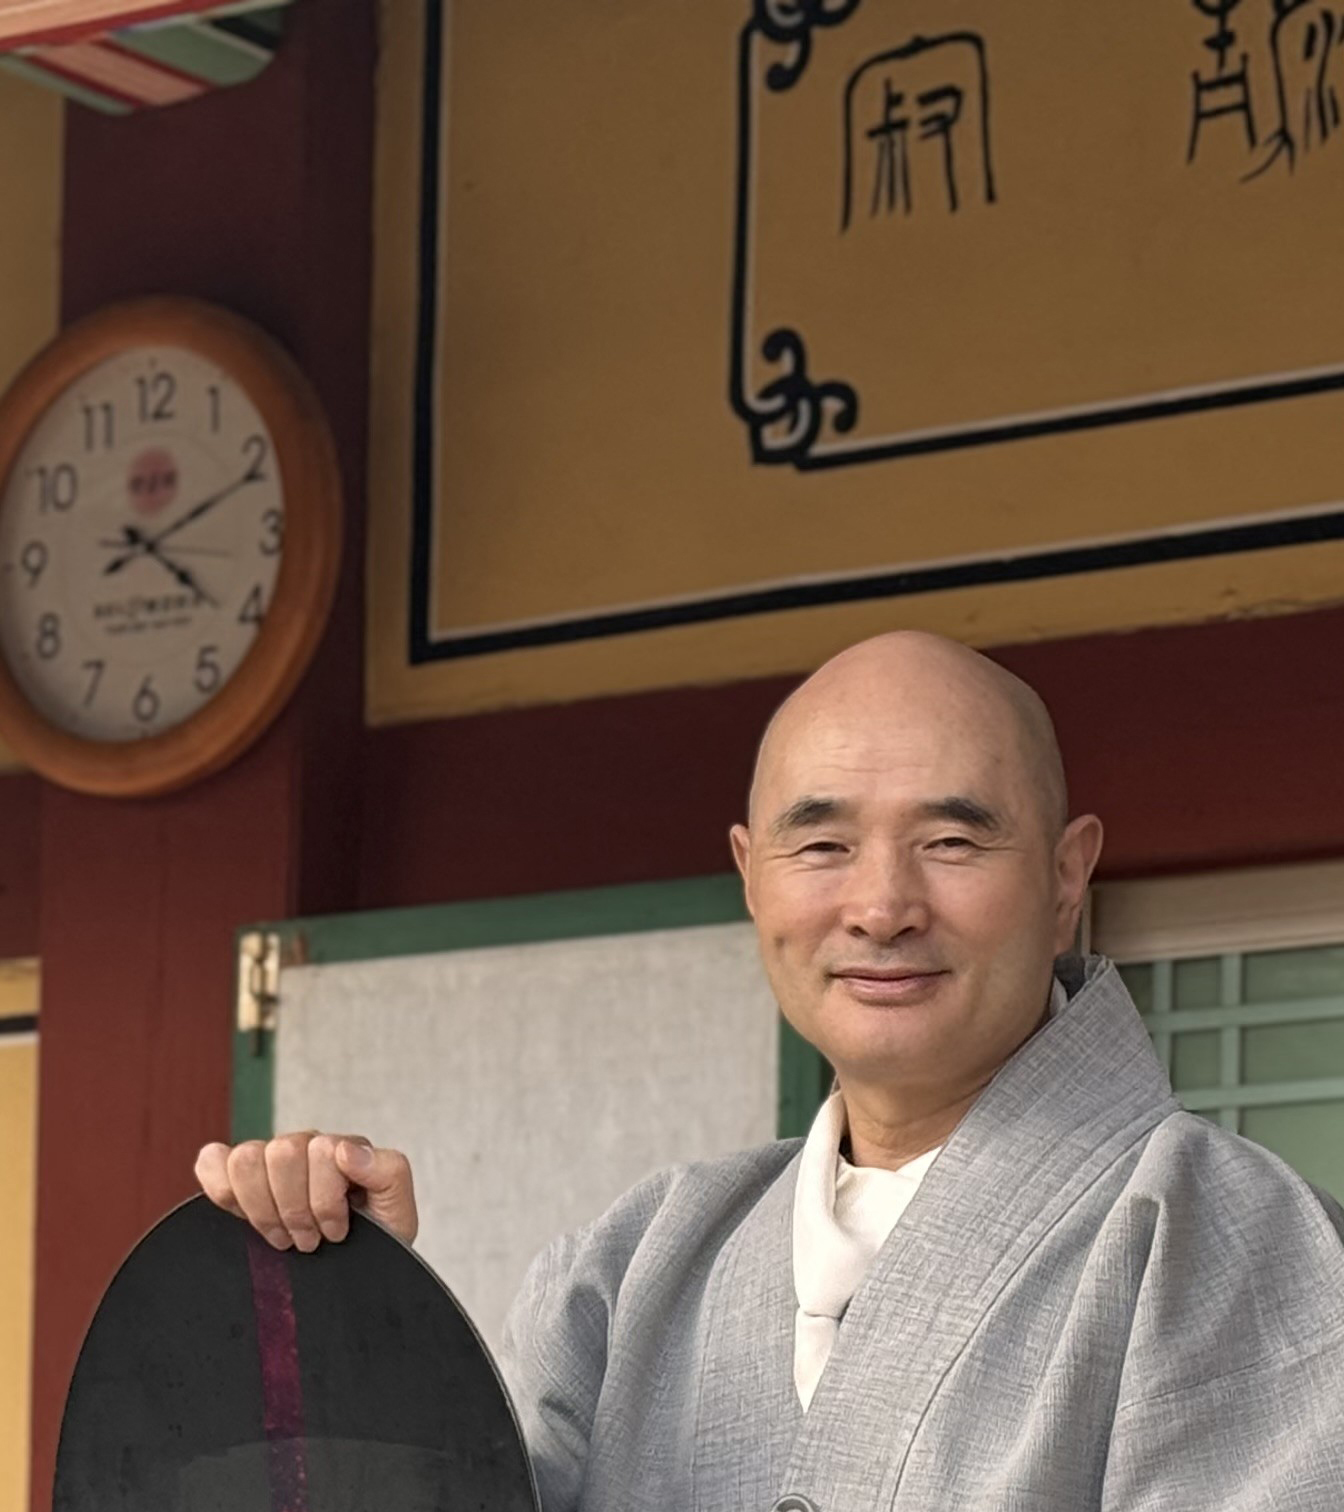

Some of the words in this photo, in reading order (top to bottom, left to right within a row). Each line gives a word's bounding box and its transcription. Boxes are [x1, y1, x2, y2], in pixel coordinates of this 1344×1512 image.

[135, 372, 176, 424] 12
[208, 385, 221, 432] 1
[82, 402, 114, 452] 11
[242, 435, 268, 482] 2
[36, 463, 78, 514] 10
[260, 509, 283, 557] 3
[21, 541, 48, 588] 9
[237, 585, 265, 626] 4
[36, 612, 62, 660] 8
[82, 659, 106, 707] 7
[194, 646, 223, 694] 5
[132, 675, 160, 723] 6
